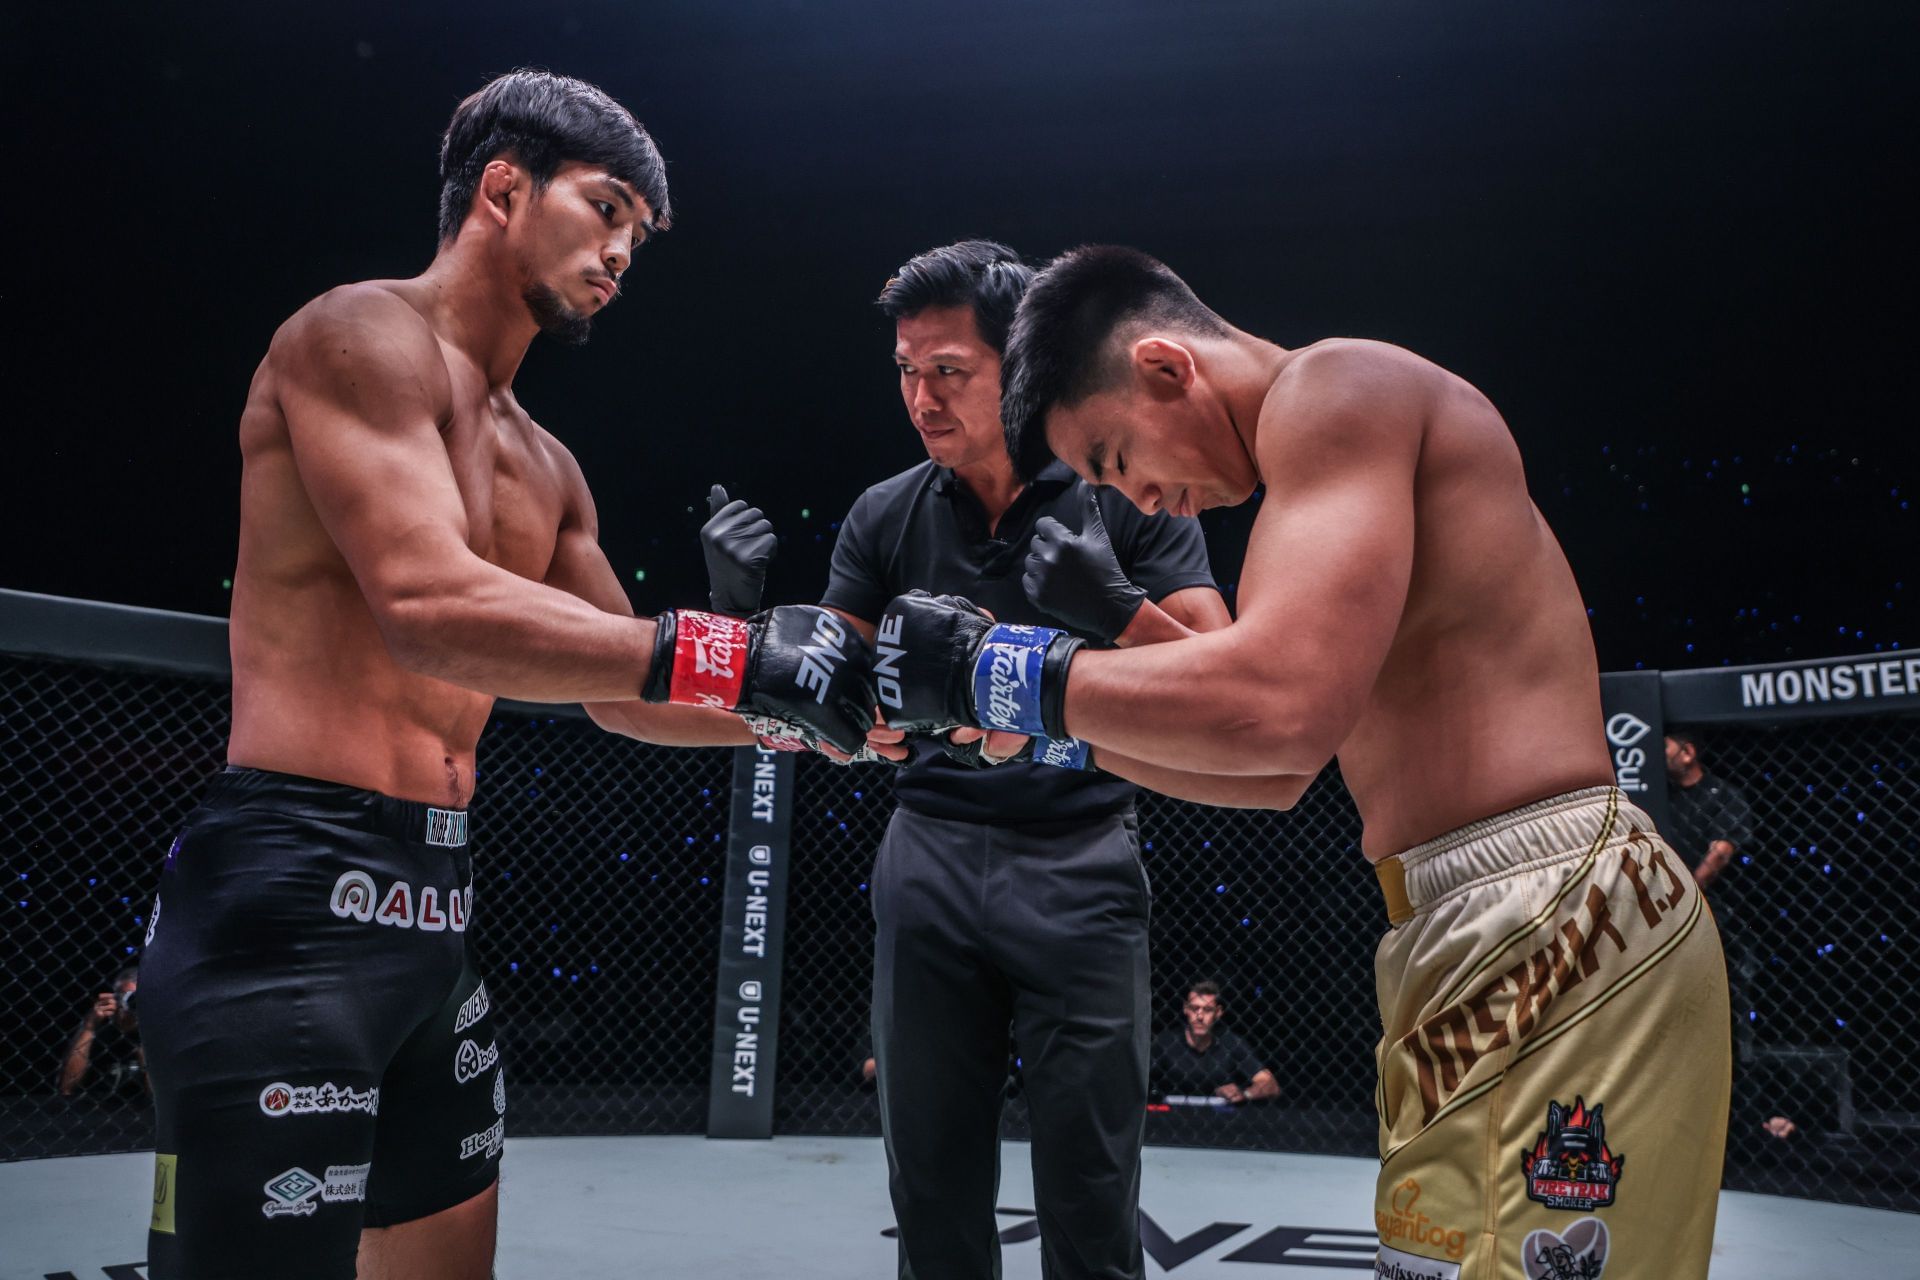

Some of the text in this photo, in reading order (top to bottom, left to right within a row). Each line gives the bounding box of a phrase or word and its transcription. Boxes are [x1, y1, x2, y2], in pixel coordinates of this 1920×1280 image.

[795, 613, 847, 705] ONE
[872, 614, 907, 709] ONE
[742, 870, 769, 958] U-NEXT
[731, 1006, 760, 1097] U-NEXT
[1533, 1180, 1611, 1200] FIRETRAK
[1546, 1195, 1593, 1210] SMOKER
